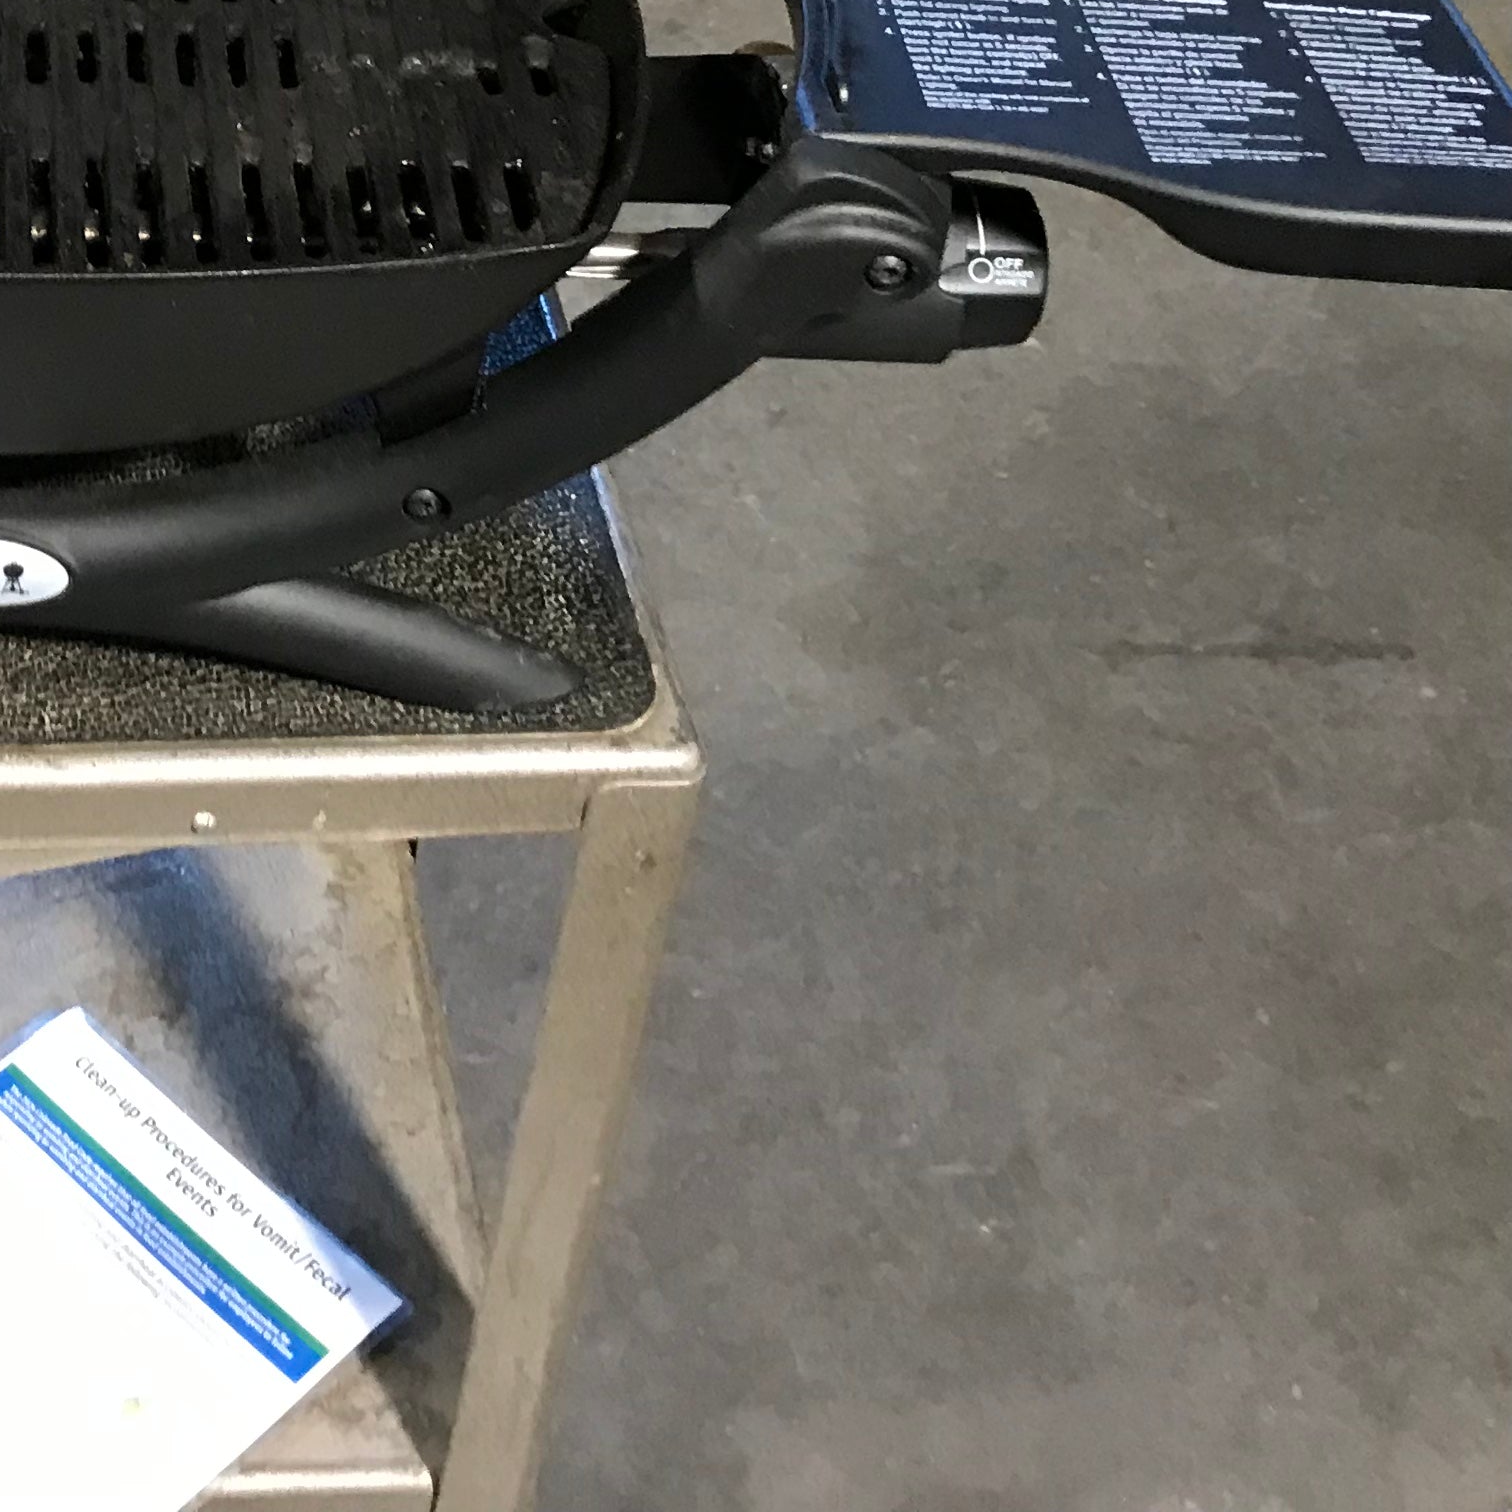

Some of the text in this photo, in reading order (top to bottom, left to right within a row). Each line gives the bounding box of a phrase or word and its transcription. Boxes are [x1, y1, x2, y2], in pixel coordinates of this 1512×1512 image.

[993, 256, 1025, 270] OFF
[74, 1055, 142, 1120] Clean-up
[140, 1115, 227, 1197] Procedures
[225, 1190, 254, 1218] for
[252, 1213, 353, 1302] Vomit/Fecal
[164, 1165, 220, 1219] Events
